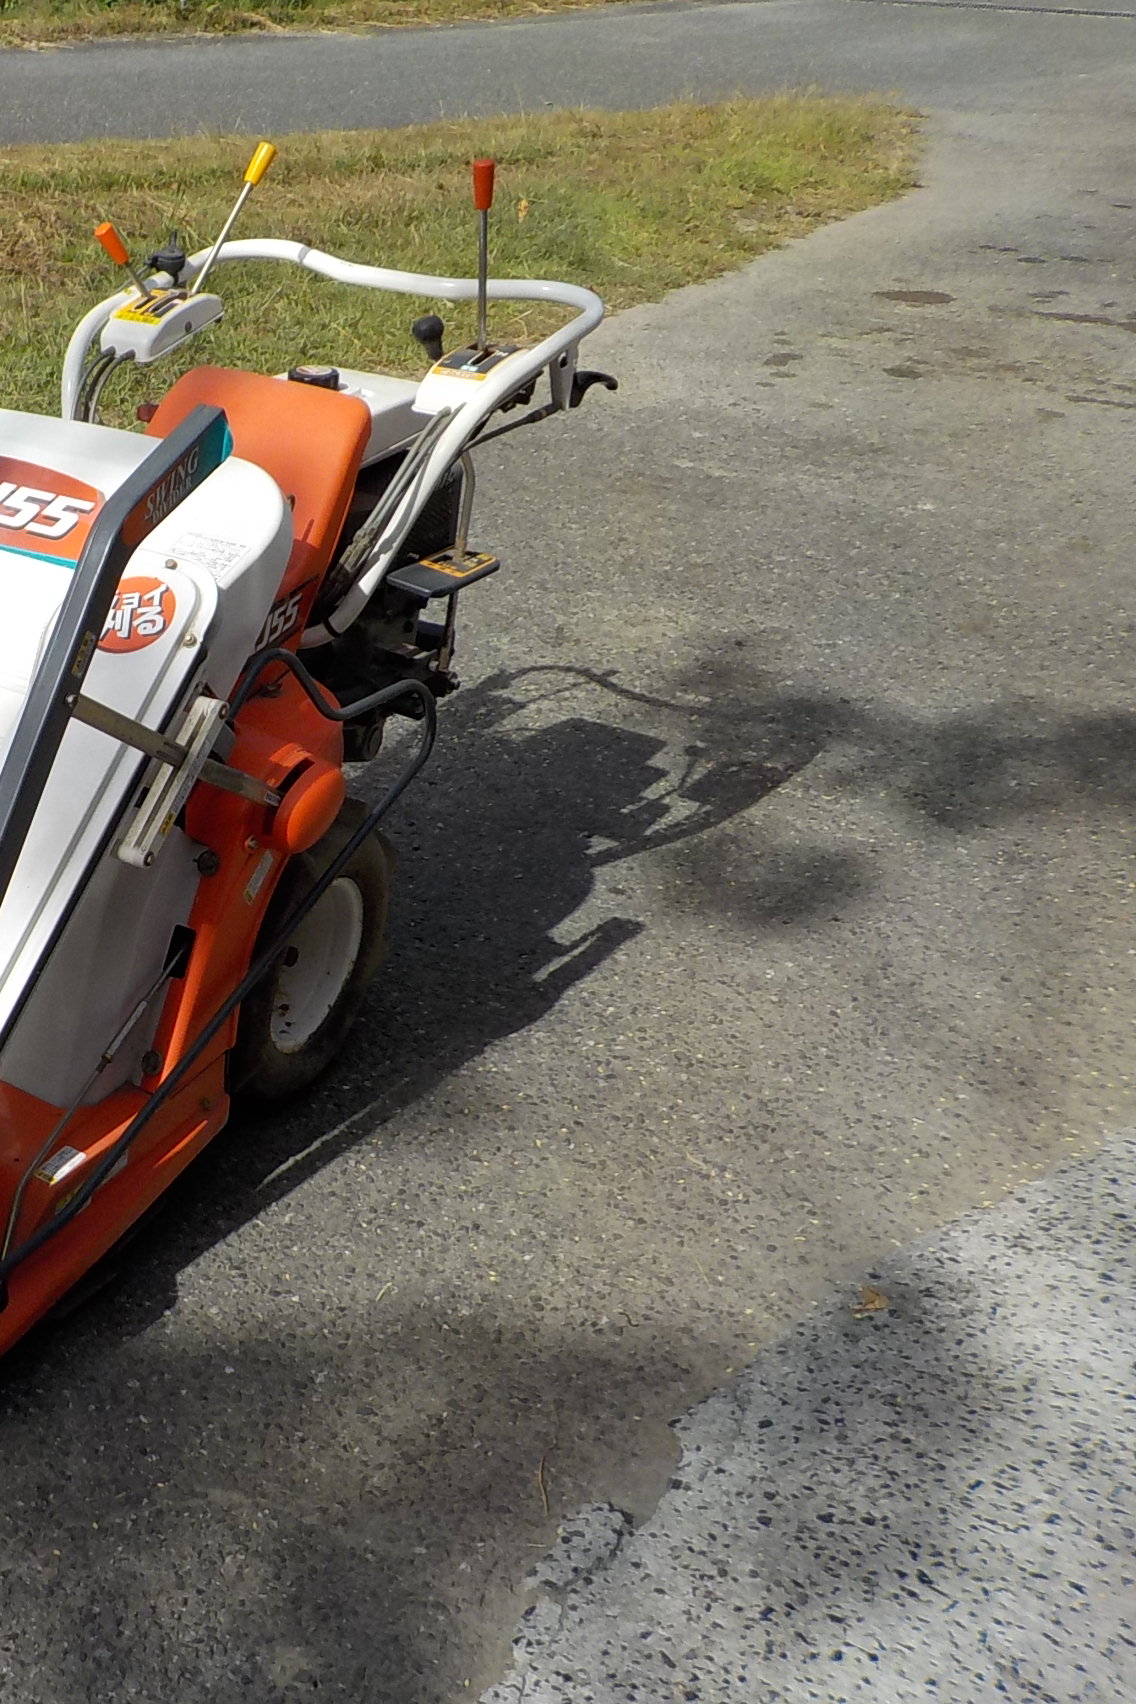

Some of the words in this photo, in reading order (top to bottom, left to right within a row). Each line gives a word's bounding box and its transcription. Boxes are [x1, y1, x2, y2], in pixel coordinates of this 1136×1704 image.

[144, 445, 200, 521] SWING
[112, 584, 168, 609] ョイ
[255, 592, 304, 652] J55
